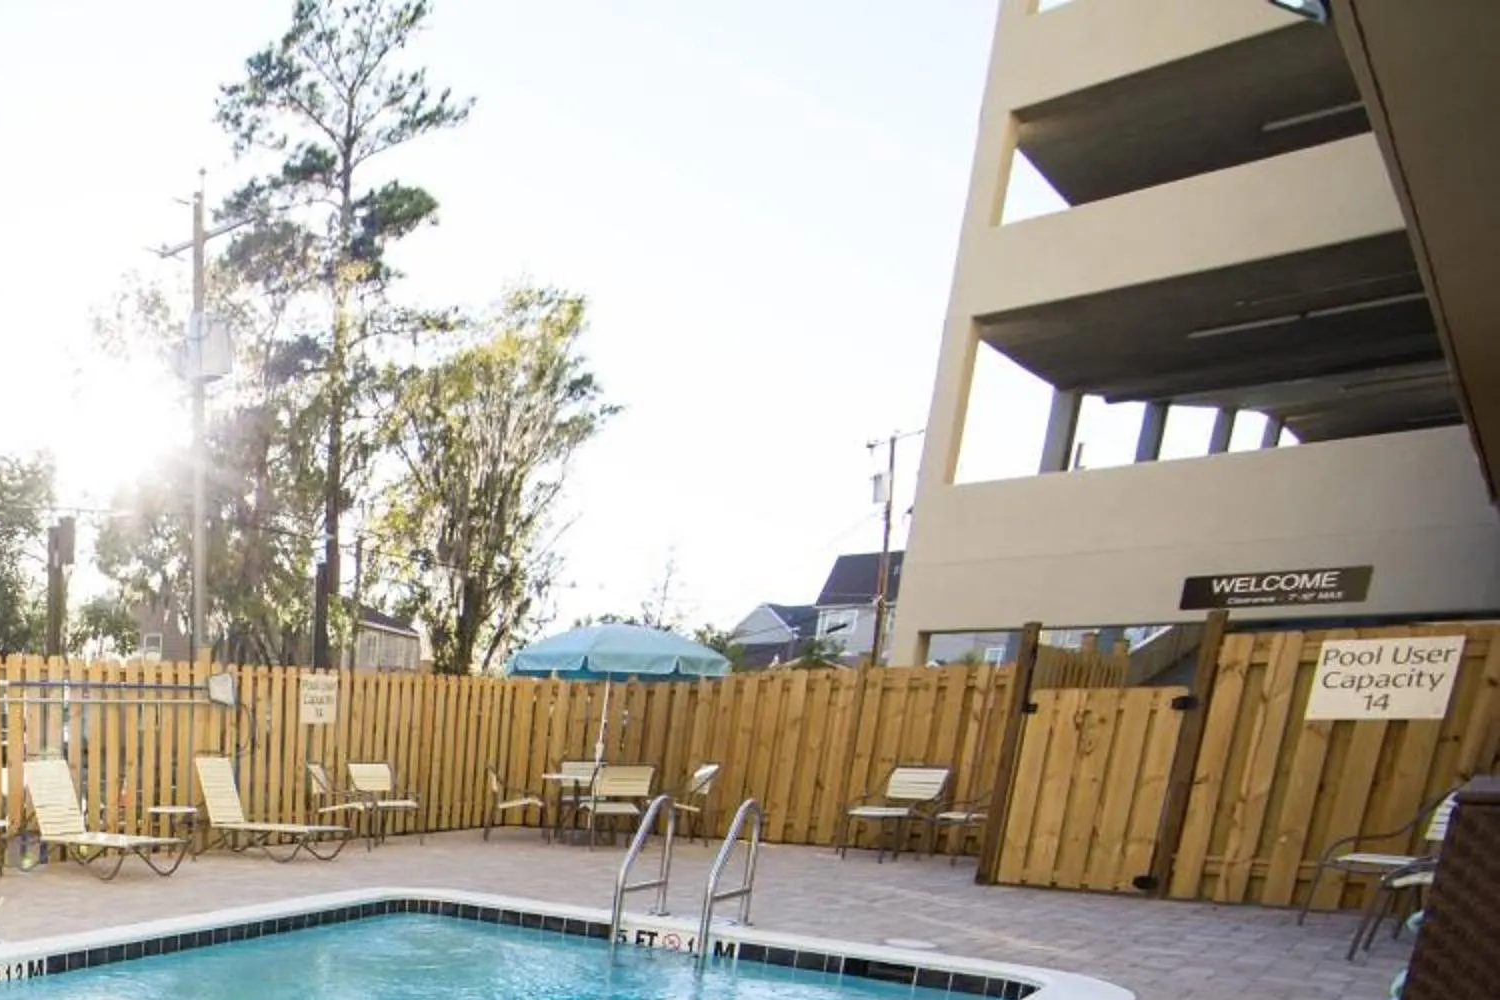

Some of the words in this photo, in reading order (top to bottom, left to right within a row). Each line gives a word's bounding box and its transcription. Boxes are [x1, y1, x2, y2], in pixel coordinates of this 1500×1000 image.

[1212, 571, 1341, 593] WELCOME
[1322, 646, 1383, 667] Pool
[1391, 645, 1456, 666] User
[1321, 668, 1445, 693] Capacity
[1363, 693, 1390, 711] 14
[635, 929, 658, 947] FT
[714, 939, 736, 958] M
[27, 958, 44, 979] M
